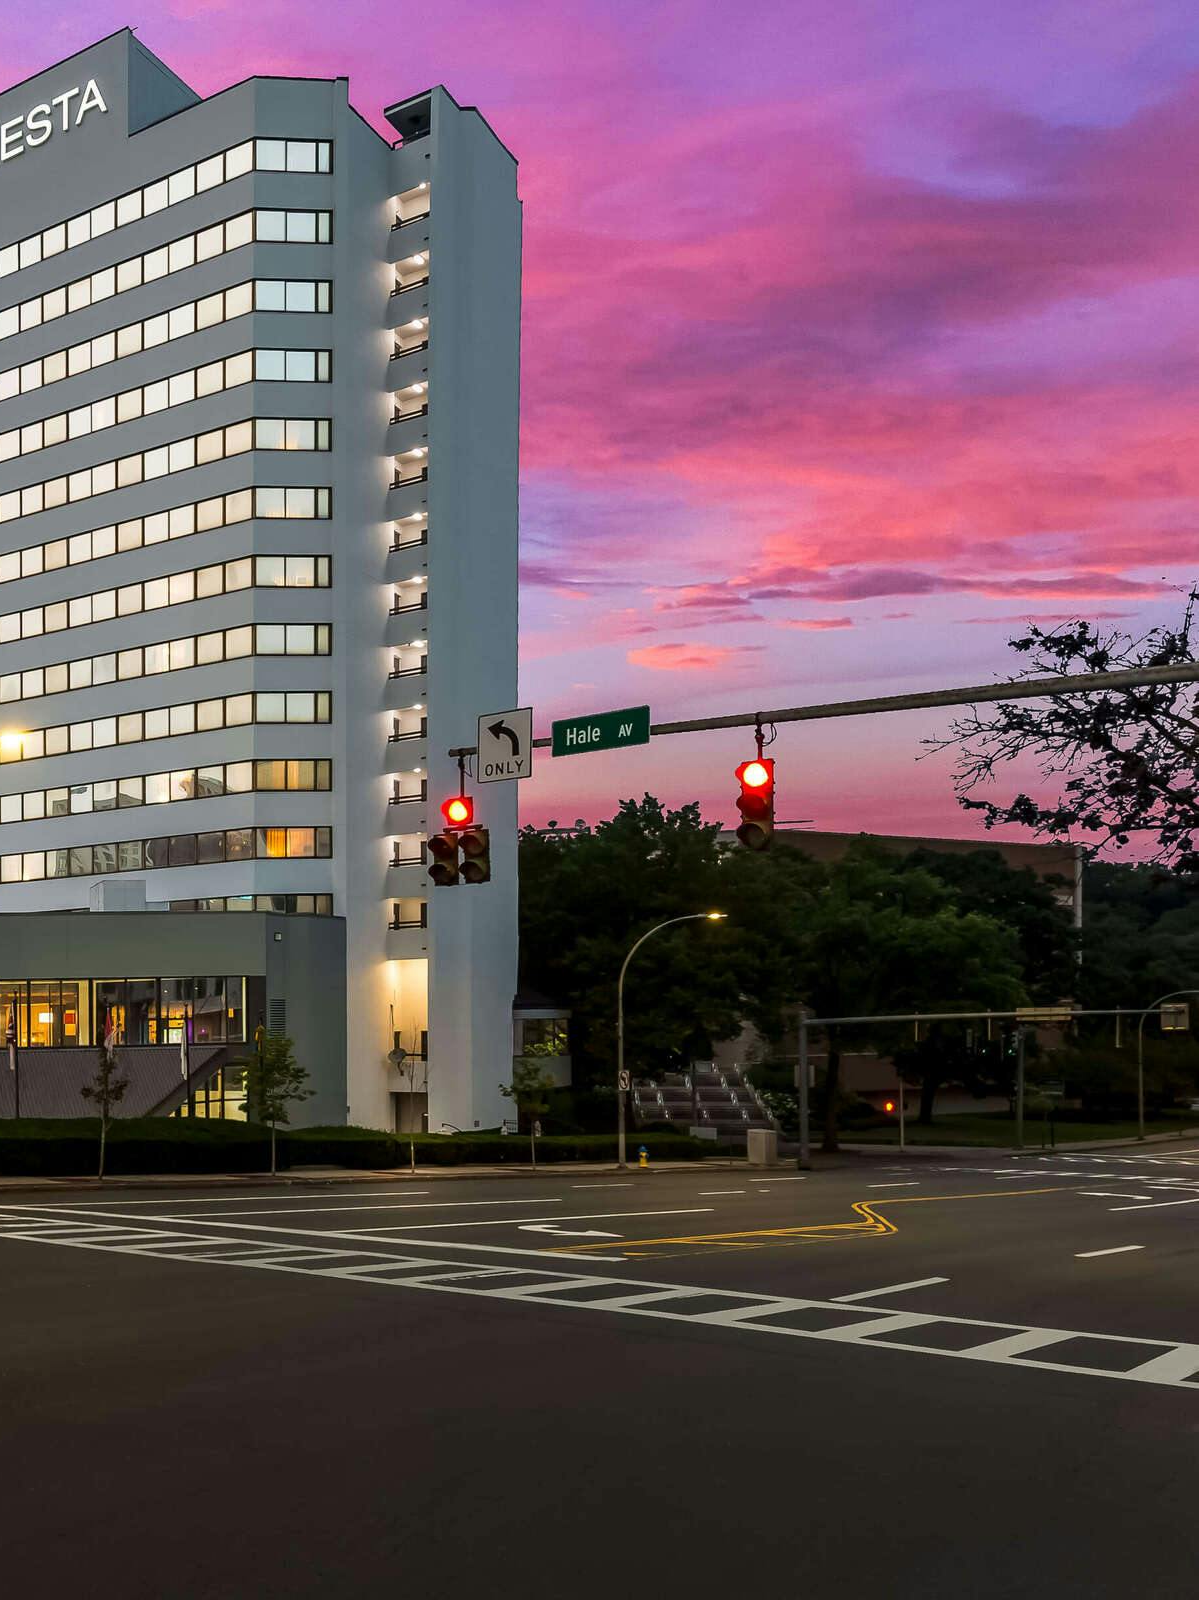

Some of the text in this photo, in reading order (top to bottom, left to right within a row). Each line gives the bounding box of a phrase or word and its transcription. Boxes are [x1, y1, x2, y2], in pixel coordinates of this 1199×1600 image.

[566, 723, 633, 746] Hale AV
[484, 759, 524, 777] ONLY
